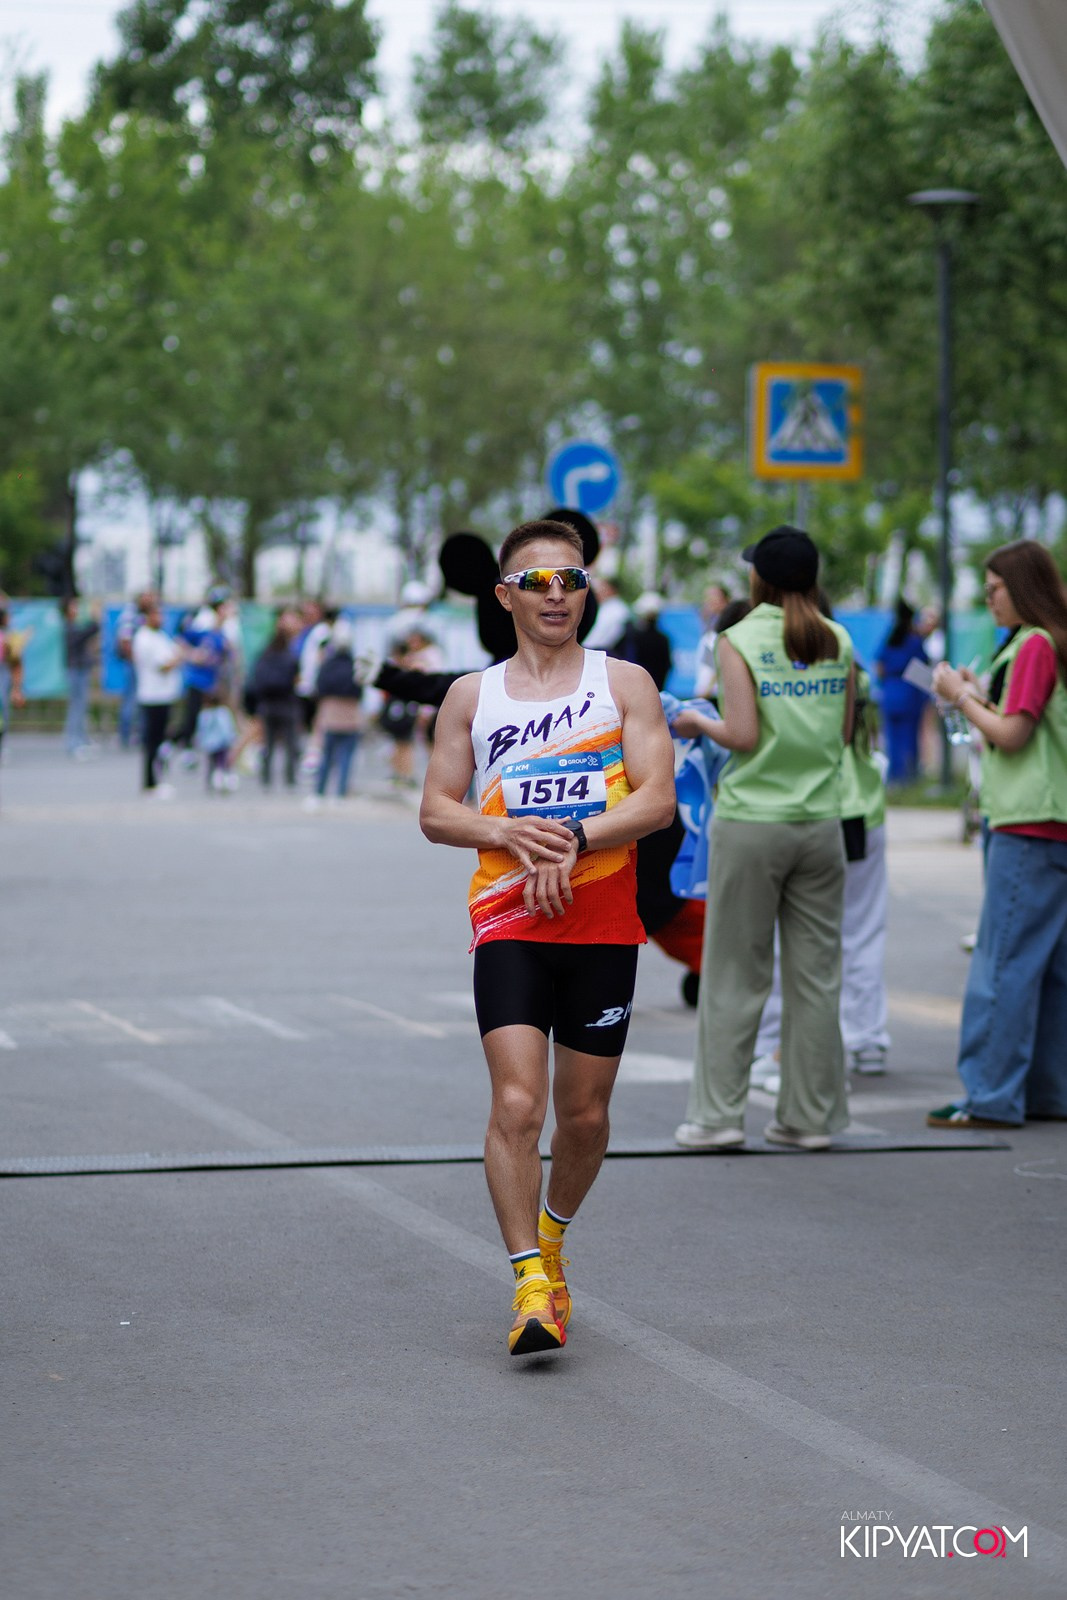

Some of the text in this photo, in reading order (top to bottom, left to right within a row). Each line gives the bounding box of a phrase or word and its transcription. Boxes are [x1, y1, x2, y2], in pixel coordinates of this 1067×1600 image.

[506, 764, 529, 773] 5 KM
[519, 775, 590, 806] 1514
